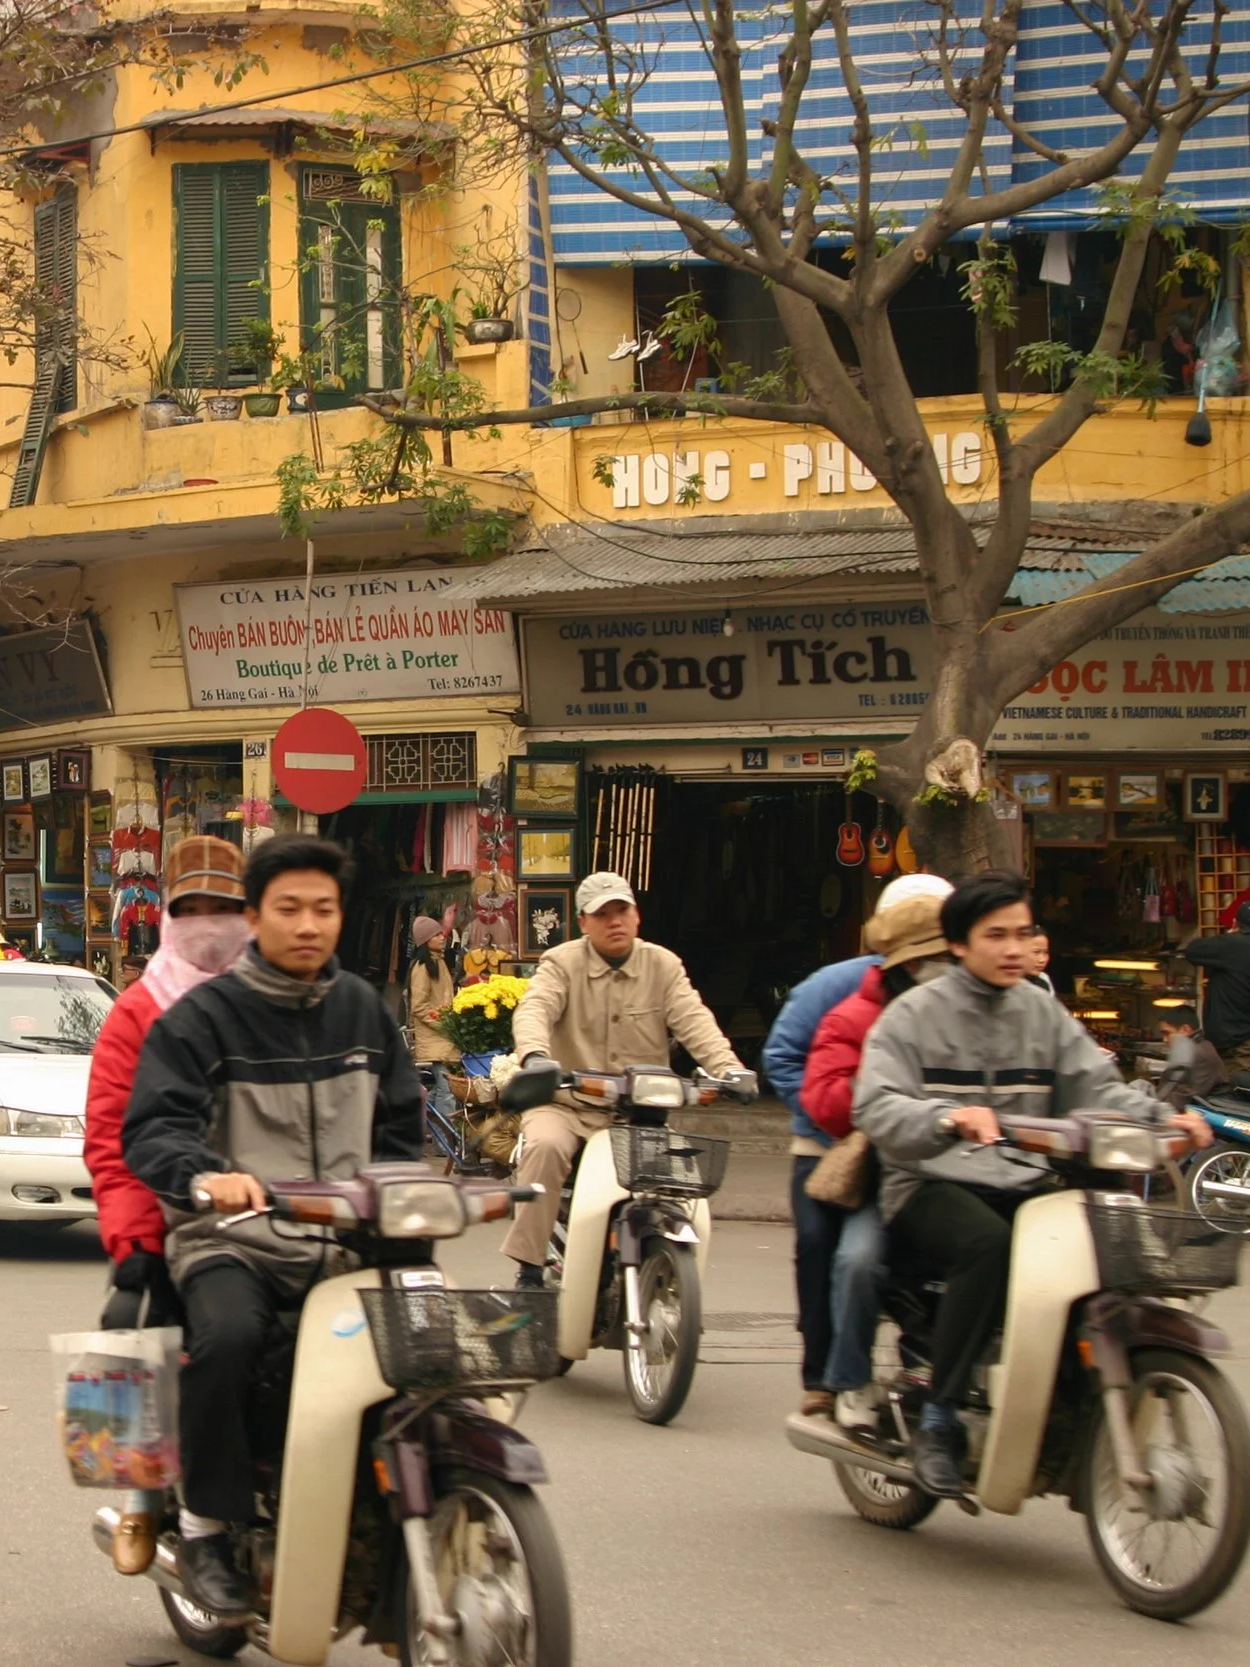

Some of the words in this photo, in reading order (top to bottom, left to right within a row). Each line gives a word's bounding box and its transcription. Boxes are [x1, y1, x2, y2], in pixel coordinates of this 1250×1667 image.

[220, 587, 264, 605] CỬA
[275, 585, 336, 603] HÀNG
[345, 577, 398, 597] TIẾN
[189, 623, 235, 656] Chuyên
[237, 616, 266, 648] BÁN
[347, 604, 366, 643] LẺ
[368, 603, 409, 642] QUẦN
[413, 605, 434, 639] ÁO
[438, 609, 469, 637] MAY
[235, 658, 312, 680] Boutique
[318, 654, 338, 674] de
[343, 652, 381, 672] Prêt
[386, 652, 397, 670] à
[401, 649, 459, 670] Porter
[767, 636, 918, 686] Tích
[1122, 653, 1214, 694] LÂM
[427, 677, 450, 690] Tel:
[453, 675, 503, 689] 8267437
[201, 689, 213, 701] 26
[216, 688, 246, 702] Hàng
[248, 687, 268, 699] Gai
[278, 685, 295, 698] Hà
[858, 694, 877, 707] TEL
[565, 703, 582, 716] 24
[1003, 705, 1063, 719] VIETNAMESE
[1066, 705, 1107, 719] CULTURE
[1111, 705, 1119, 719] &
[1122, 705, 1183, 719] TRADITIONAL
[1186, 705, 1247, 719] HANDICRAFT
[247, 743, 263, 756] 26
[746, 751, 763, 766] 24
